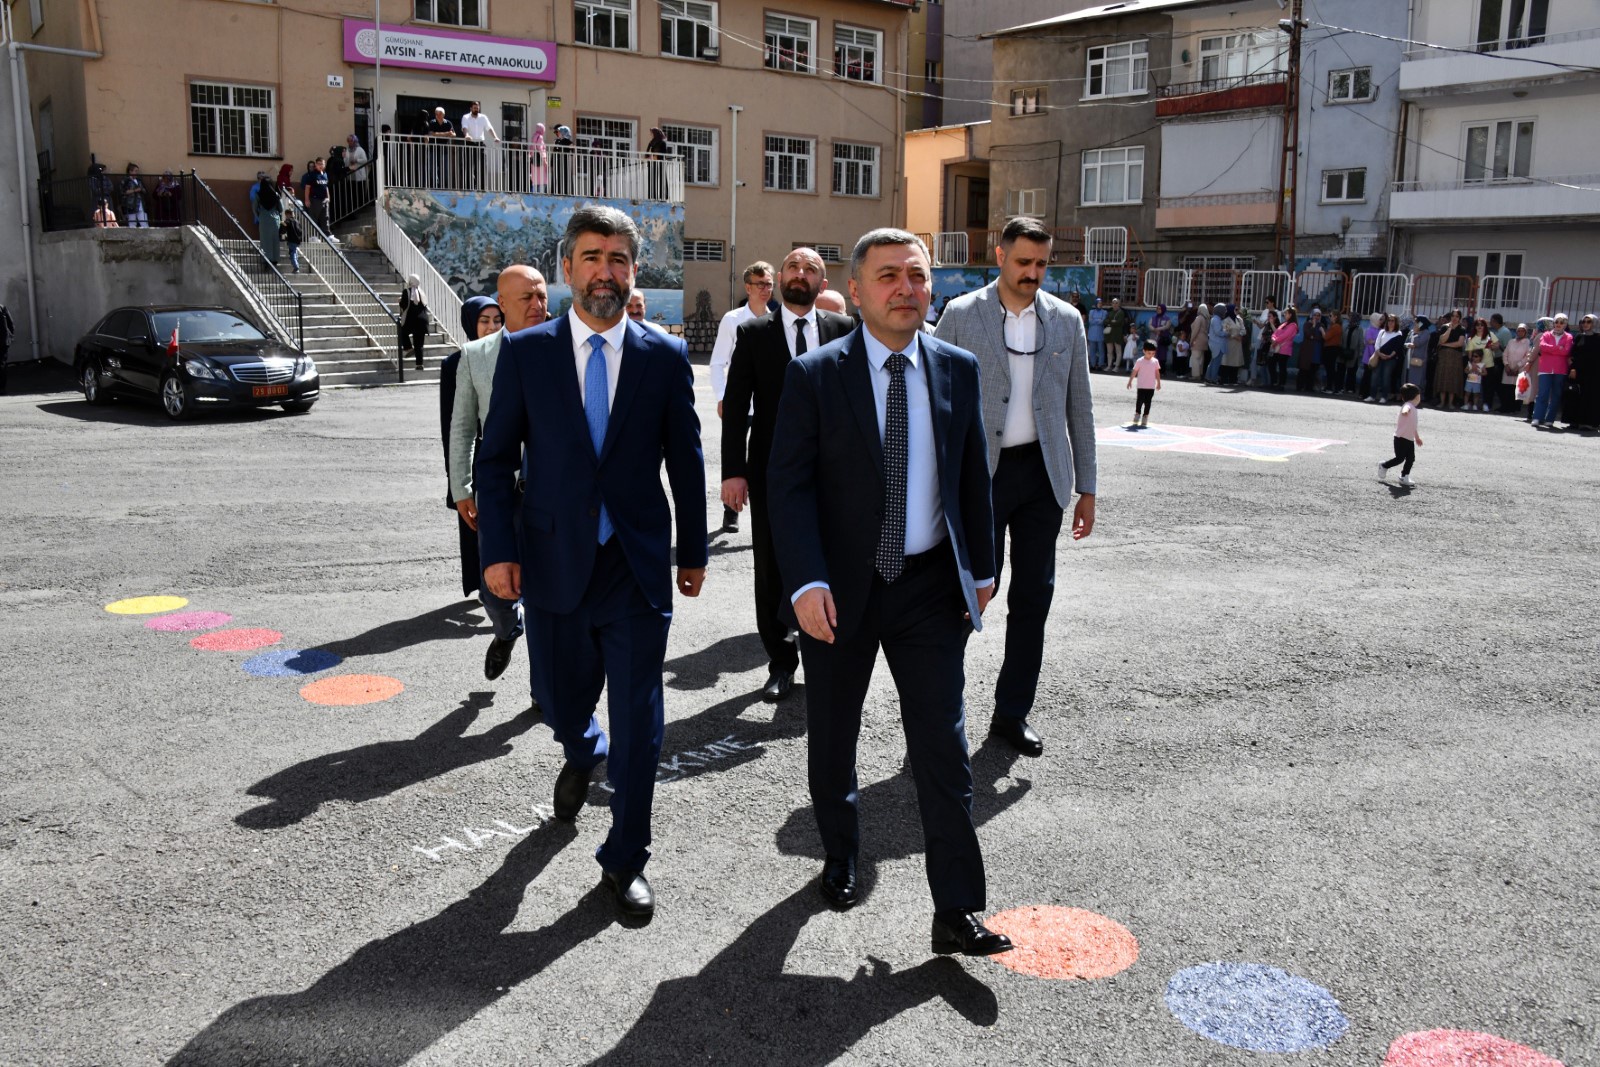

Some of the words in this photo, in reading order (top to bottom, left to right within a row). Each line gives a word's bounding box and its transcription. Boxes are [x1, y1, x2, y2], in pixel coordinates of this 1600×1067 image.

[384, 36, 424, 46] GÜMÜŞHANE
[384, 45, 416, 57] AYSIN
[424, 48, 457, 62] RAFET
[460, 53, 486, 67] ATAÇ
[487, 56, 543, 70] ANAOKULU
